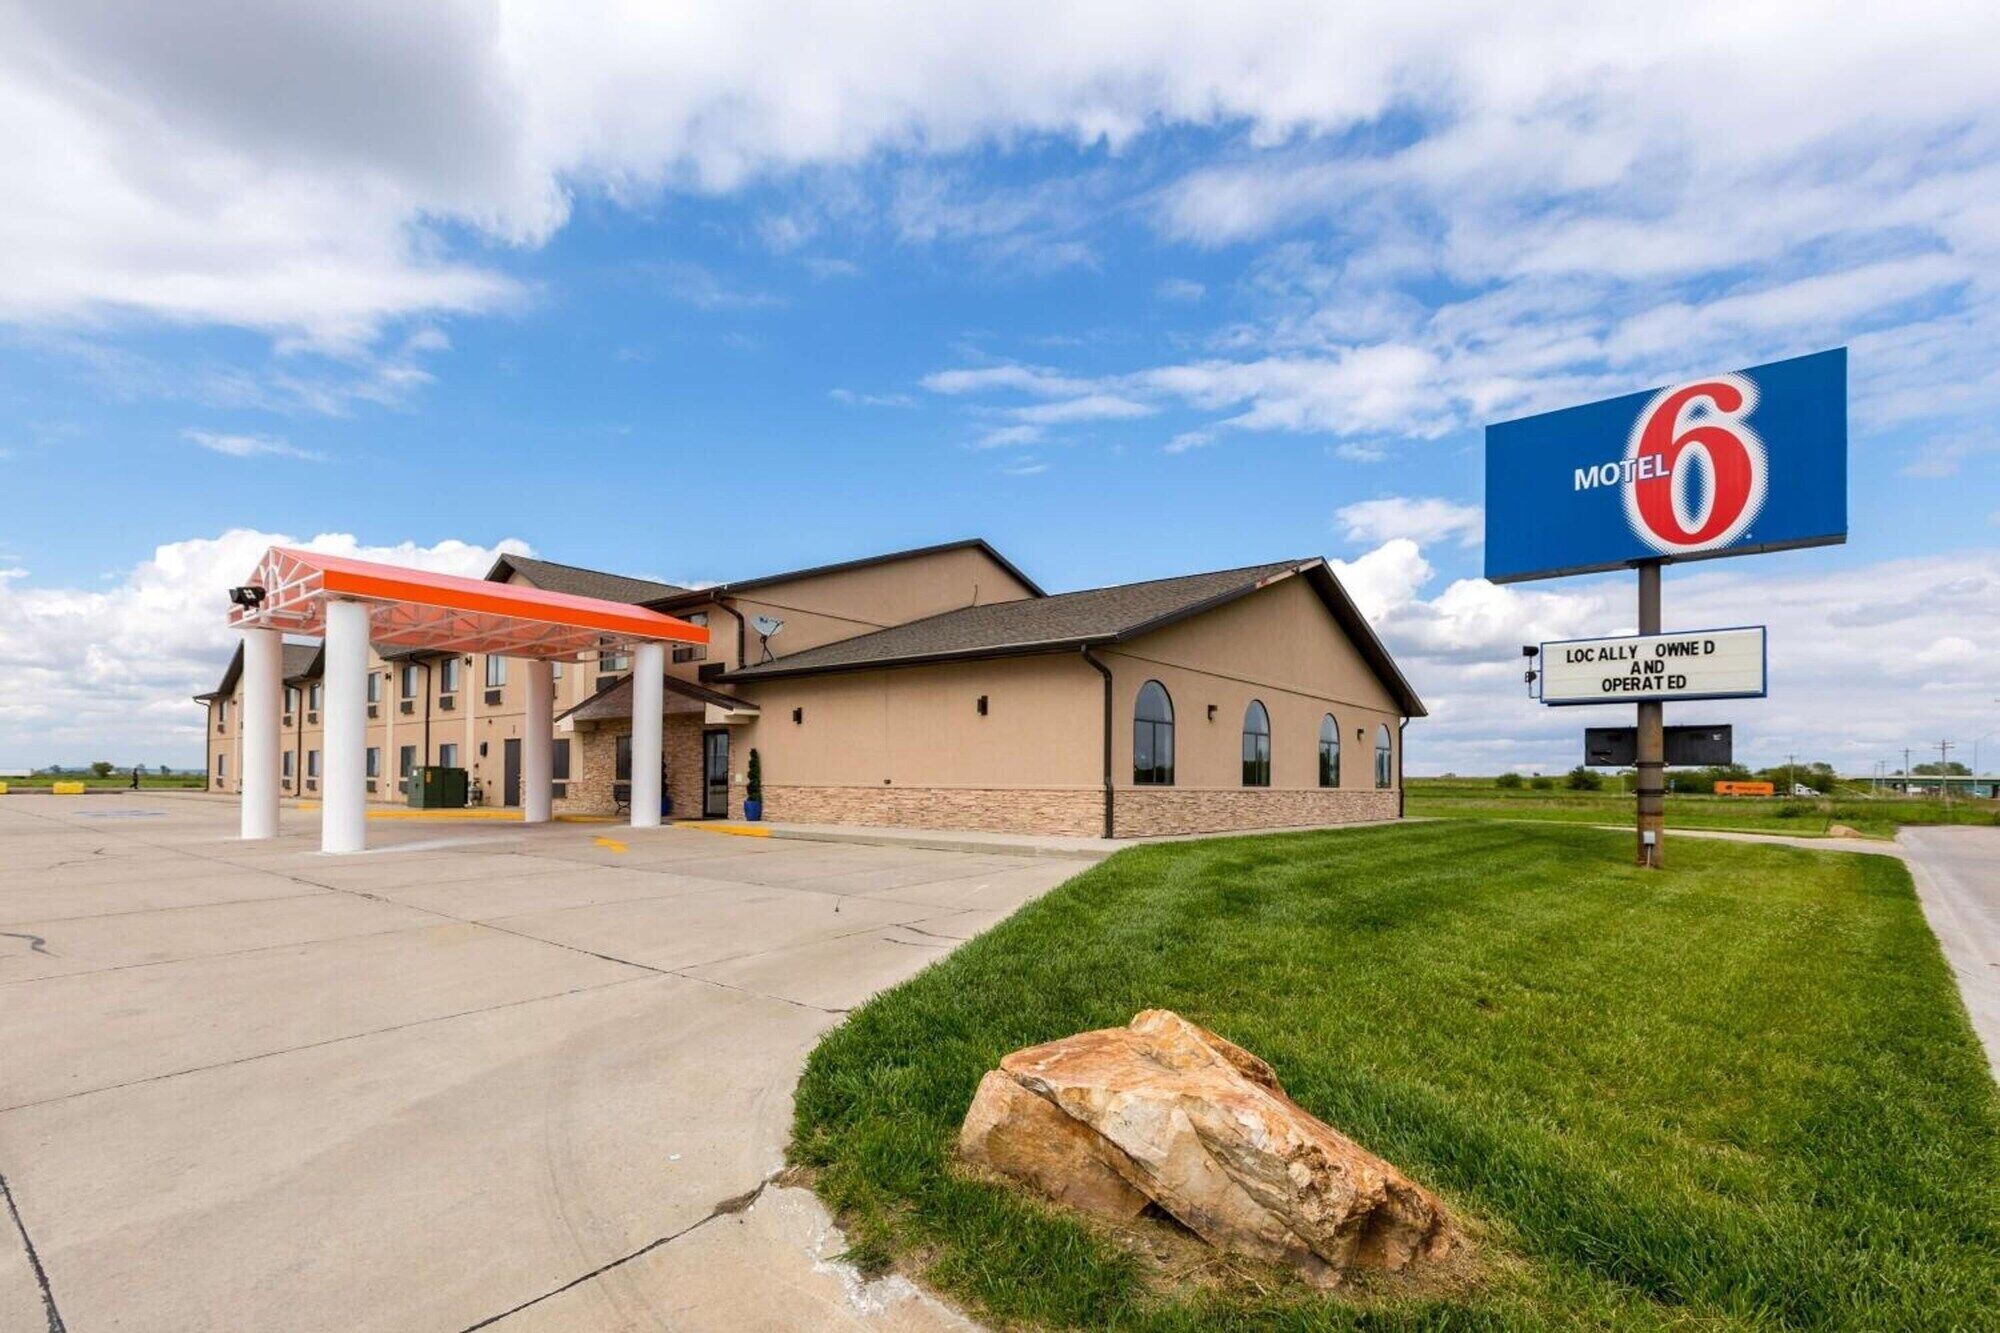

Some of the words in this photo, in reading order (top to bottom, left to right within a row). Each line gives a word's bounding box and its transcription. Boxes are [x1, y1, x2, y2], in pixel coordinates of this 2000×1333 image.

[1574, 454, 1670, 491] MOTEL
[1633, 381, 1755, 548] 6
[1566, 645, 1638, 664] LOCALLY
[1655, 640, 1715, 656] OWNED
[1631, 660, 1664, 675] AND
[1602, 675, 1686, 692] OPERATED
